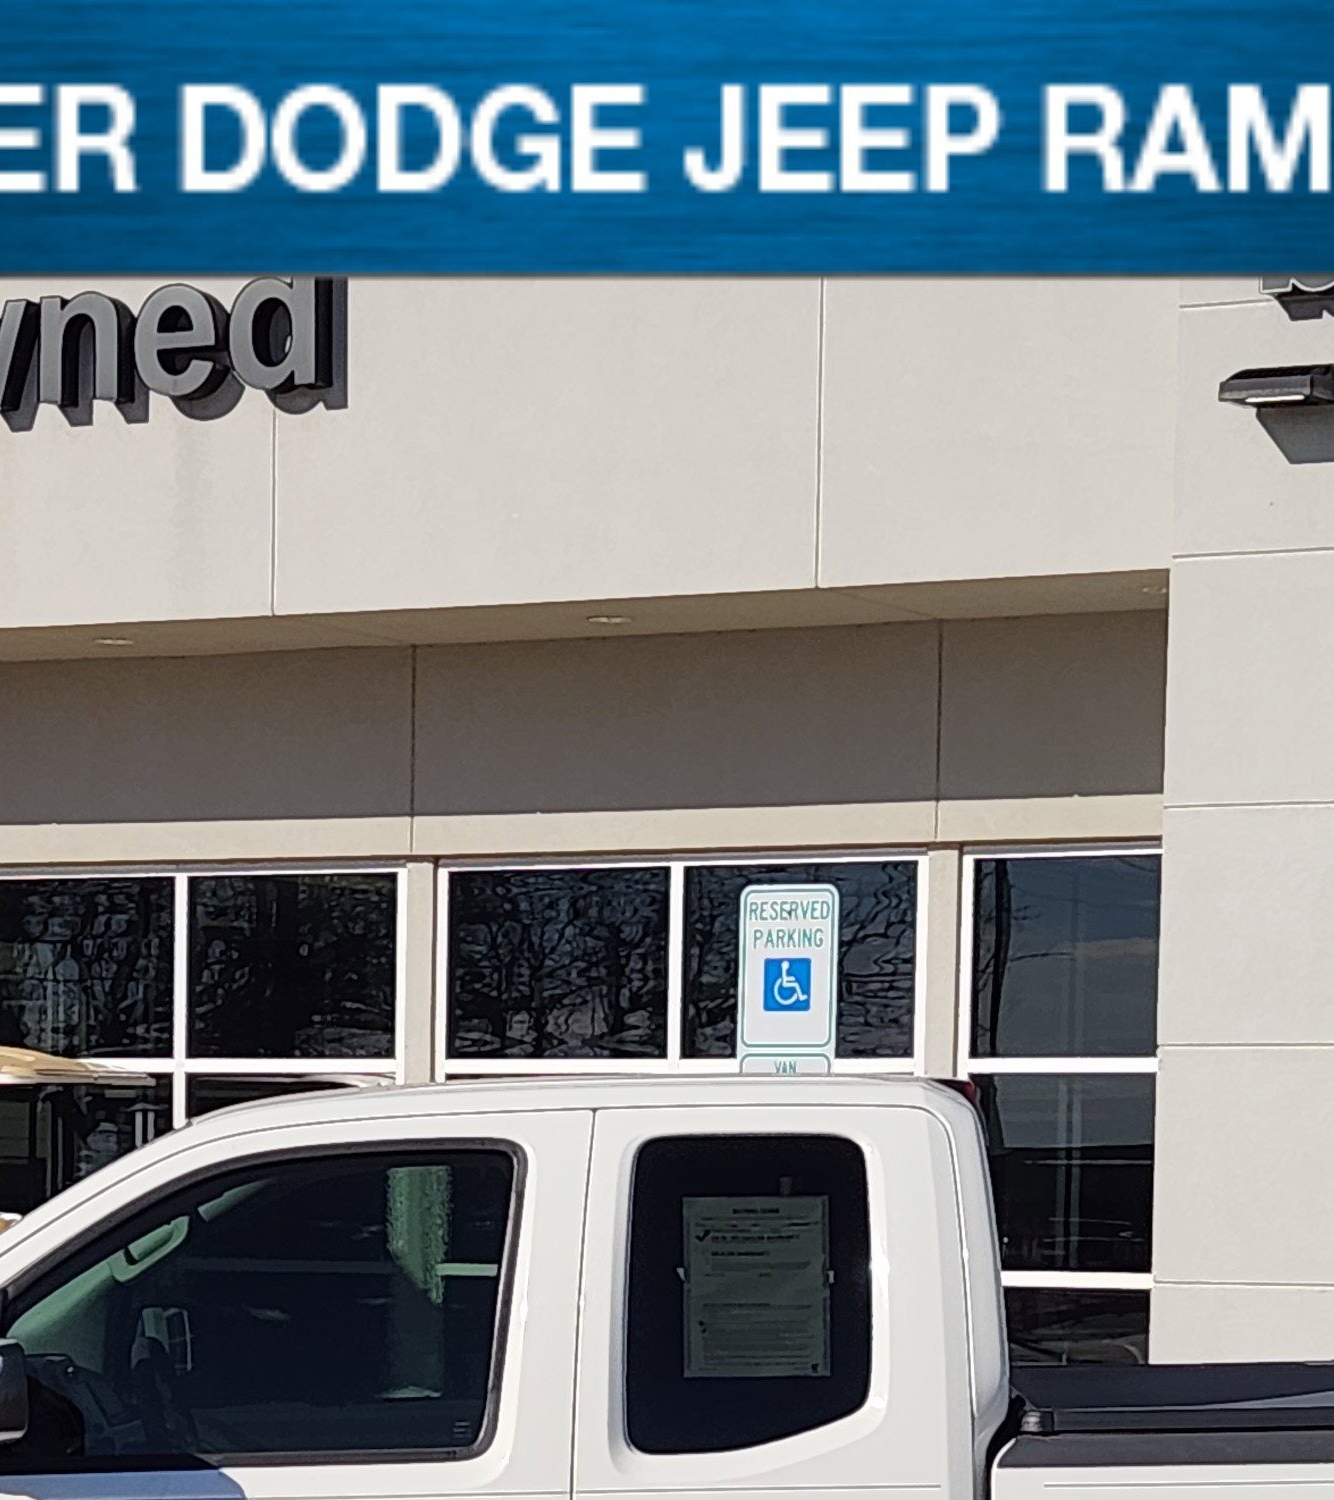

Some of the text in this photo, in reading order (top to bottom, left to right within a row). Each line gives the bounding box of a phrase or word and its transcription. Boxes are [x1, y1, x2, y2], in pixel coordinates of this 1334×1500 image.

[749, 901, 830, 921] RESERVED
[753, 928, 824, 949] PARKING
[774, 1061, 797, 1074] VAN
